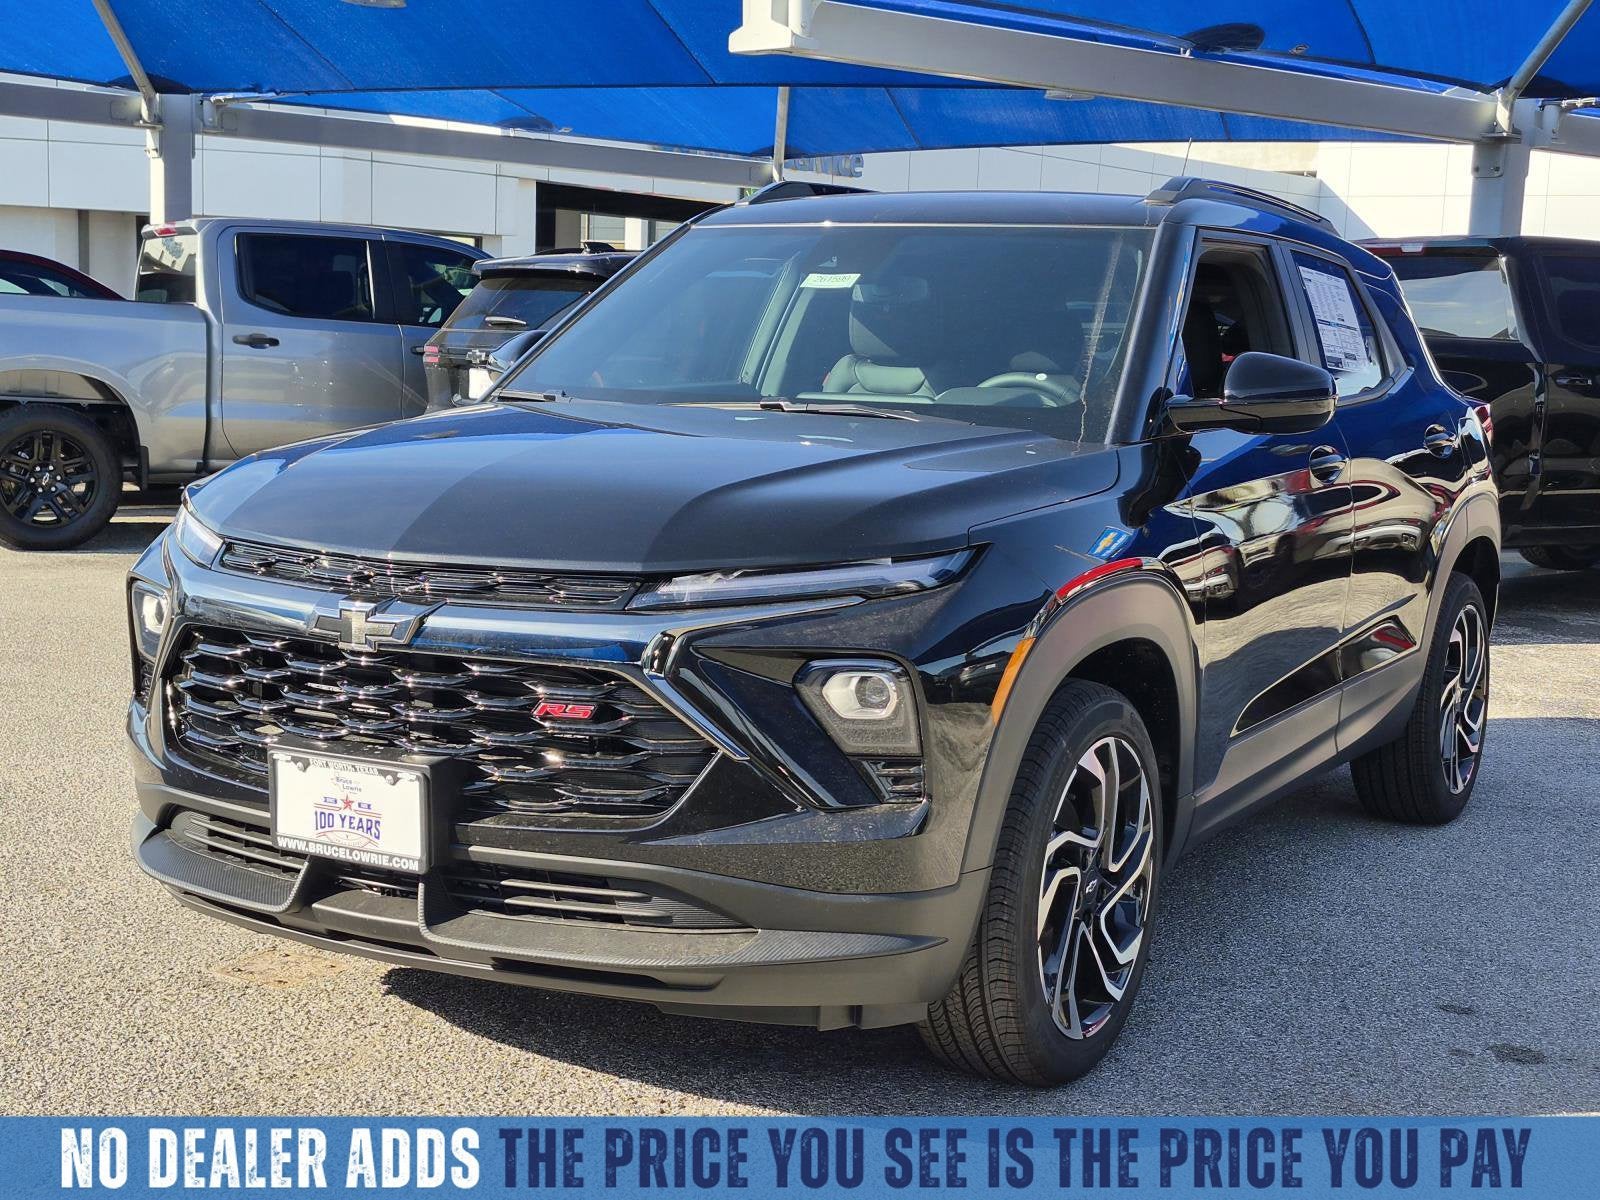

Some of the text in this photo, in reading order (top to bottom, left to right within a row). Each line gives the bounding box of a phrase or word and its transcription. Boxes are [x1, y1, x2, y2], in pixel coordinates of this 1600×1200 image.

[532, 702, 595, 719] RS
[310, 758, 326, 769] FORT
[314, 810, 381, 840] 100 YEARS
[277, 836, 419, 871] WWW.BRUCELOWRIE.COM
